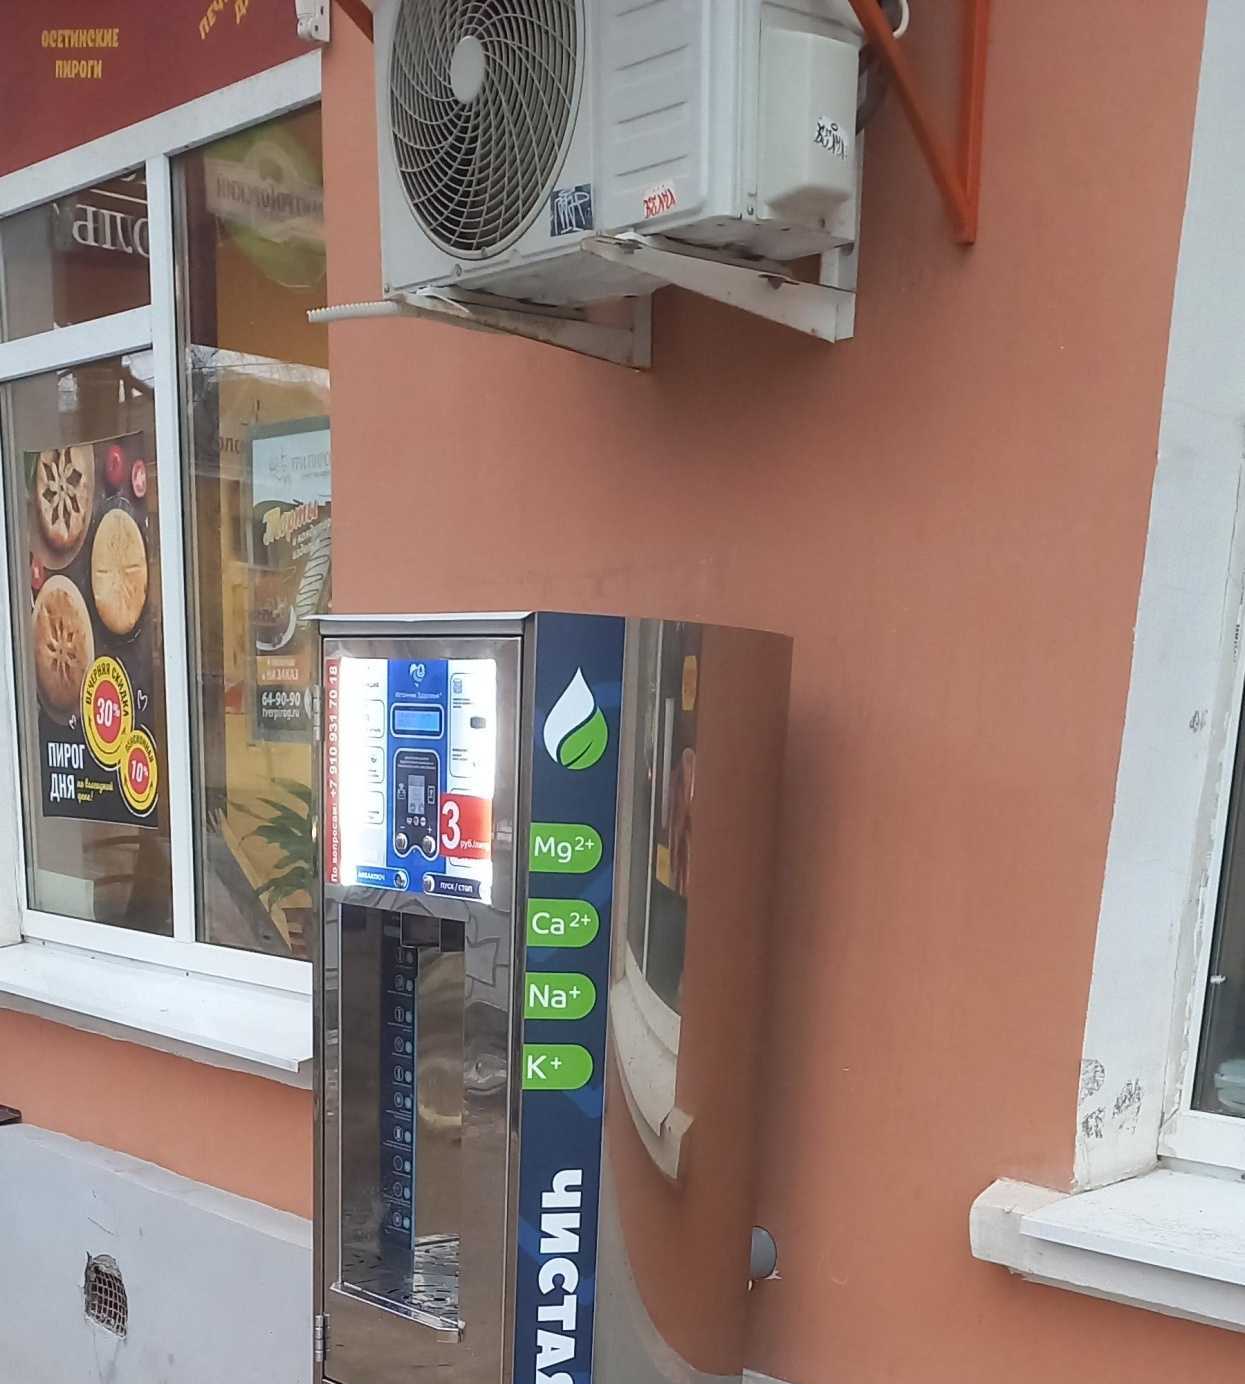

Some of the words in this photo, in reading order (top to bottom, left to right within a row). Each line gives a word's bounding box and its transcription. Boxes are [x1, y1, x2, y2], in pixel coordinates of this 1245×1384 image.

[41, 28, 119, 48] ОСЕТИНСКИЕ
[55, 59, 103, 79] ПИРОГИ
[329, 665, 337, 684] 18
[261, 691, 301, 706] 64-90-90
[329, 689, 337, 709] 70
[96, 697, 121, 727] 30%
[329, 715, 337, 742] 931
[48, 742, 85, 770] ПИРОГ
[329, 746, 337, 774] 910
[50, 773, 76, 802] ДНЯ
[441, 800, 461, 850] 3
[534, 836, 595, 863] Mg2+
[529, 983, 581, 1008] Na+
[527, 1055, 562, 1079] K+
